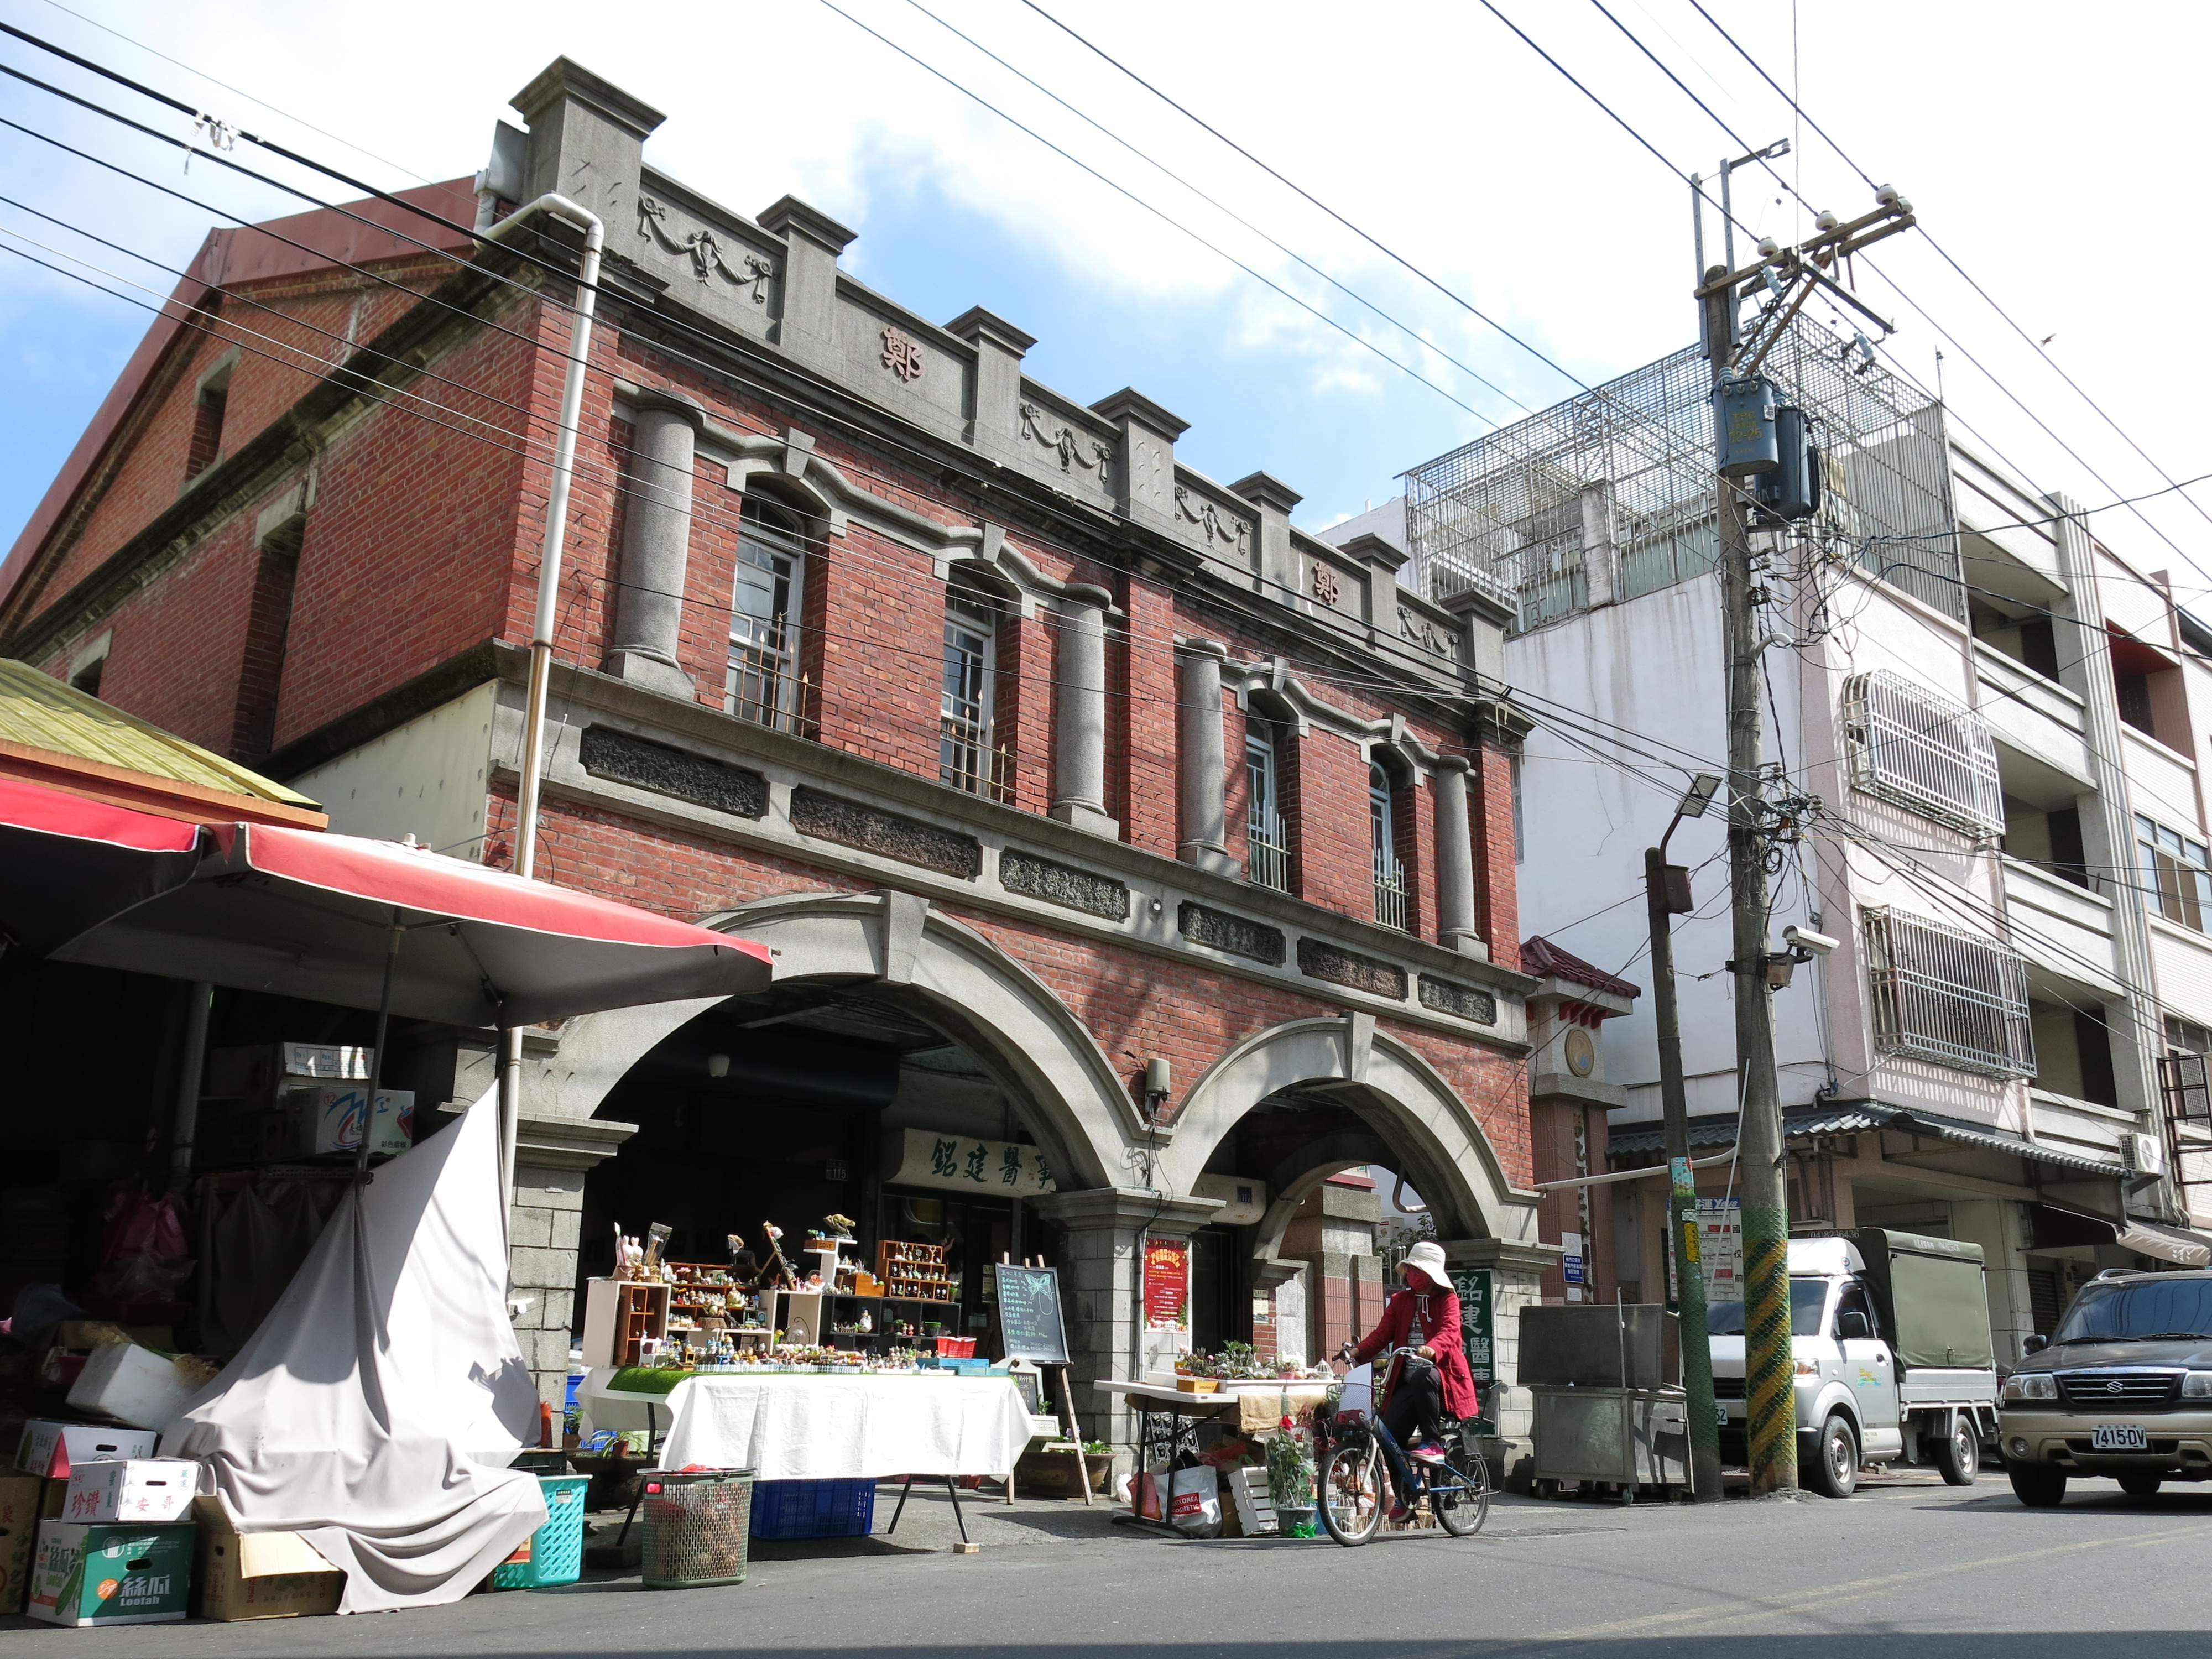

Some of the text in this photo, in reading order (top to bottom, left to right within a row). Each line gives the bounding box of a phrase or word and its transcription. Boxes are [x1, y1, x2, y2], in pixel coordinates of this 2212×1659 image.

[883, 326, 924, 382] 鄭
[1314, 562, 1341, 604] 鄭
[833, 1168, 846, 1179] 115
[2091, 1430, 2145, 1446] 7415-DV
[119, 1575, 171, 1598] 絲瓜
[120, 1596, 160, 1606] Loofah
